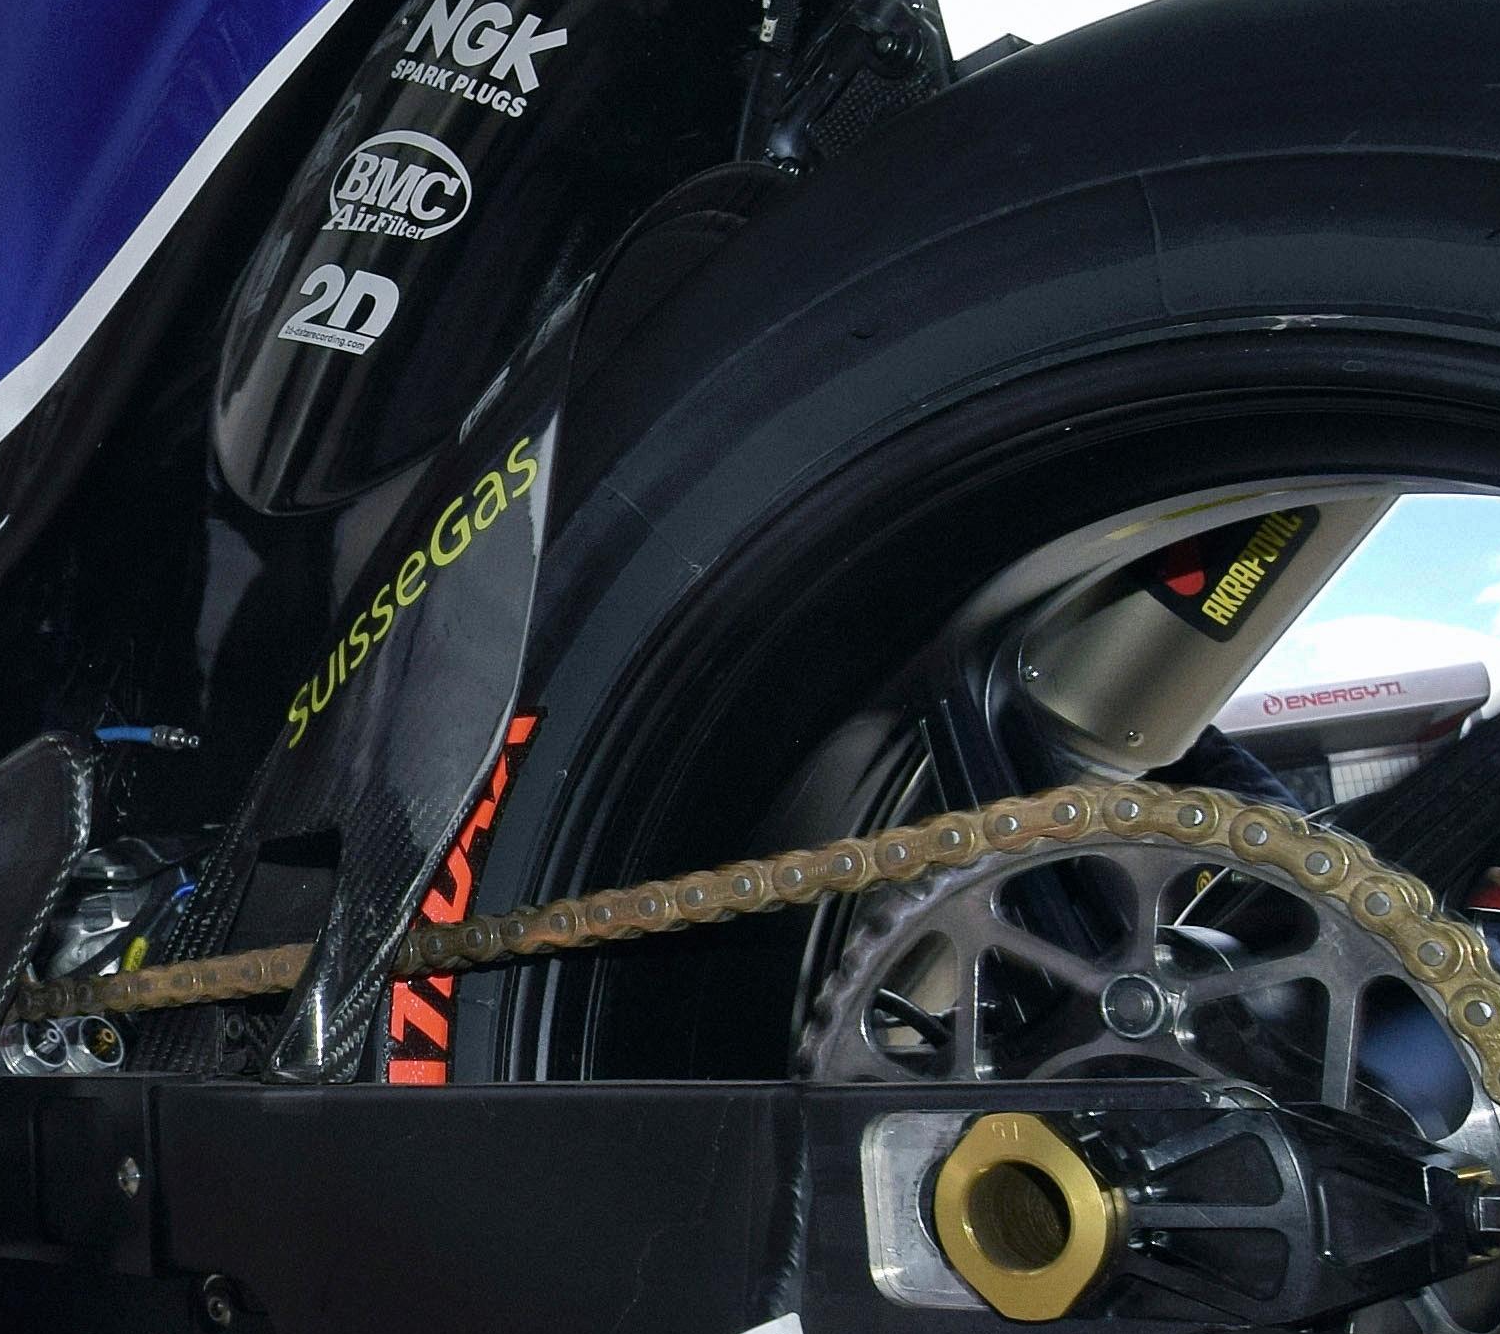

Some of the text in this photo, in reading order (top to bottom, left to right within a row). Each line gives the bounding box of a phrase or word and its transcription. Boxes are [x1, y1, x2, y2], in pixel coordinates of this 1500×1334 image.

[391, 58, 528, 117] SPARK PLUGS
[336, 152, 462, 220] BMC
[278, 263, 400, 338] 2D
